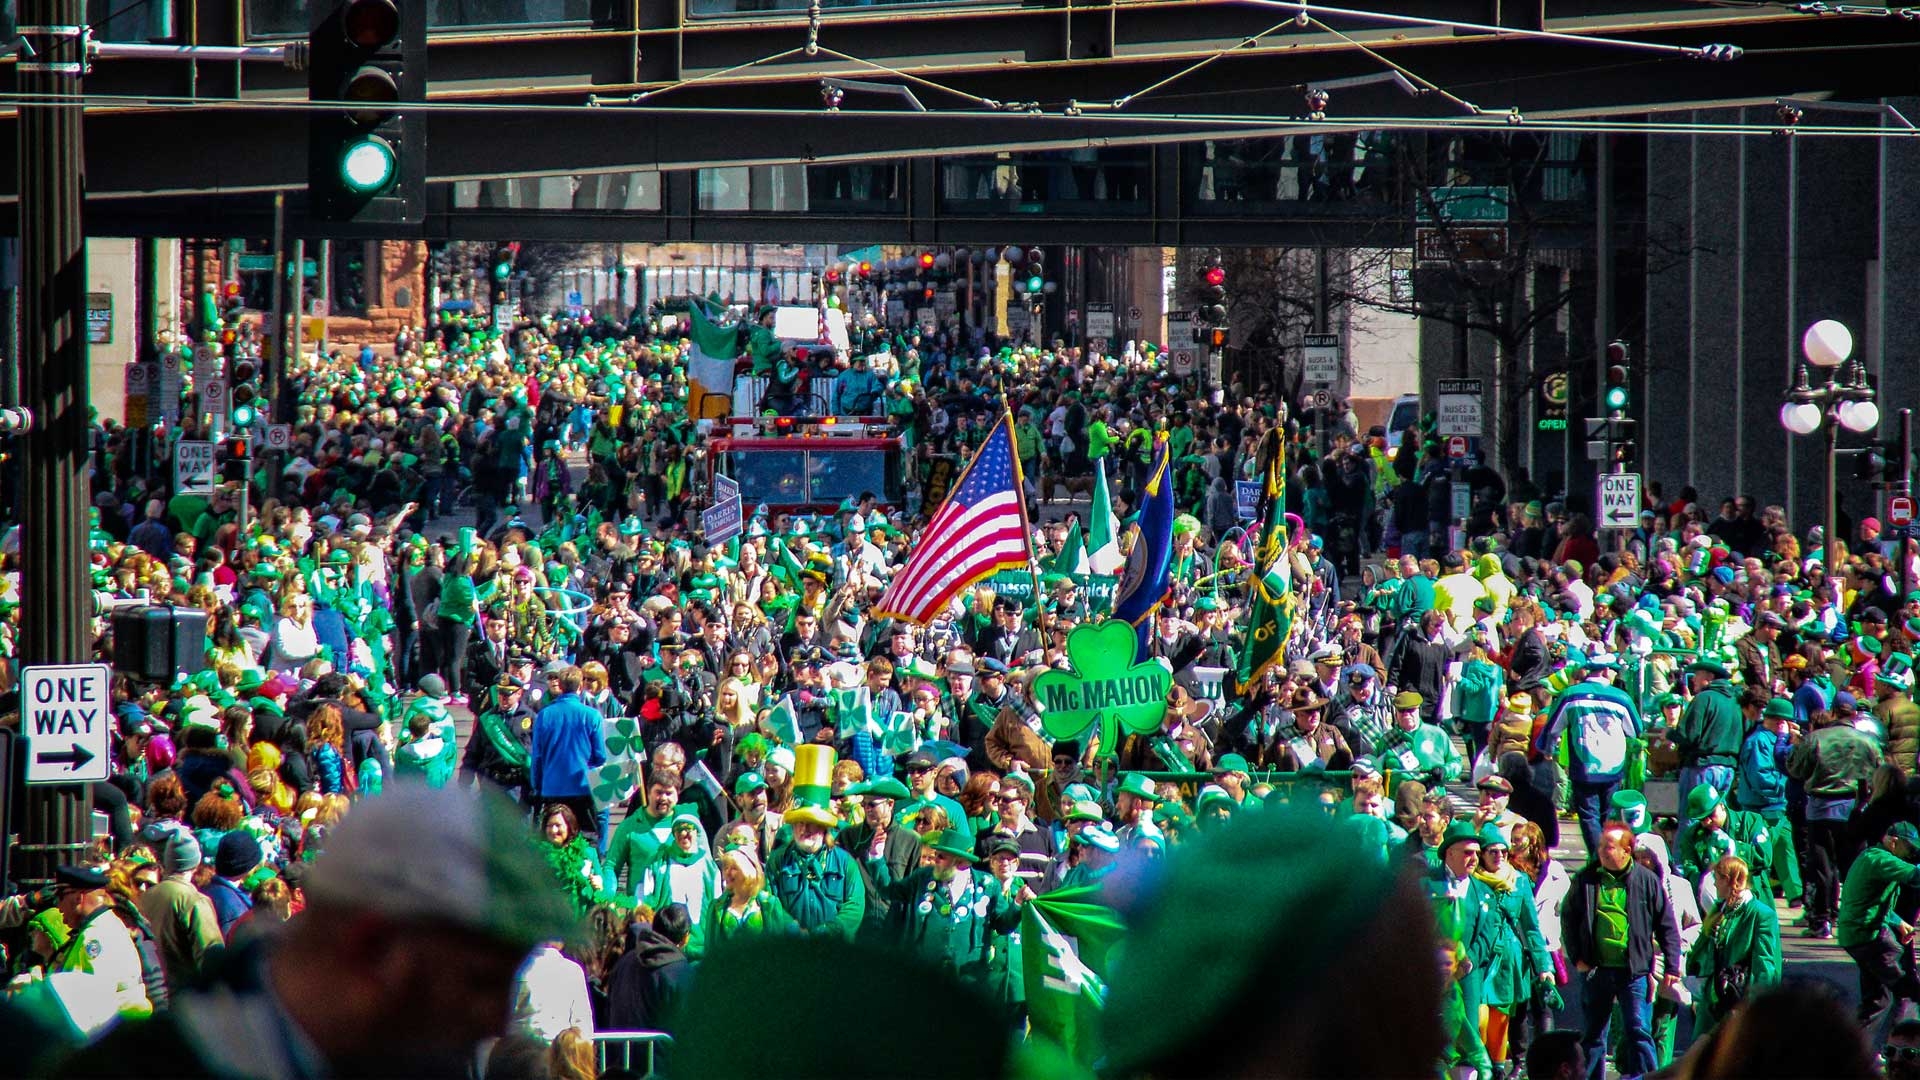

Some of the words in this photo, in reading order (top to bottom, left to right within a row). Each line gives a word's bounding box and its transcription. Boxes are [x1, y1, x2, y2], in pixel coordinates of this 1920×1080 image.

[1440, 382, 1460, 392] RIGHT
[1462, 382, 1480, 392] LANE
[1444, 405, 1467, 413] BUSES
[1452, 424, 1468, 432] ONLY
[1538, 419, 1567, 430] OPEN
[180, 446, 210, 458] ONE
[179, 461, 210, 473] WAY
[1605, 479, 1635, 491] ONE
[1604, 493, 1635, 506] WAY
[707, 503, 737, 523] DARREN
[1254, 619, 1277, 642] OF
[35, 677, 96, 704] ONE
[34, 708, 98, 736] WAY
